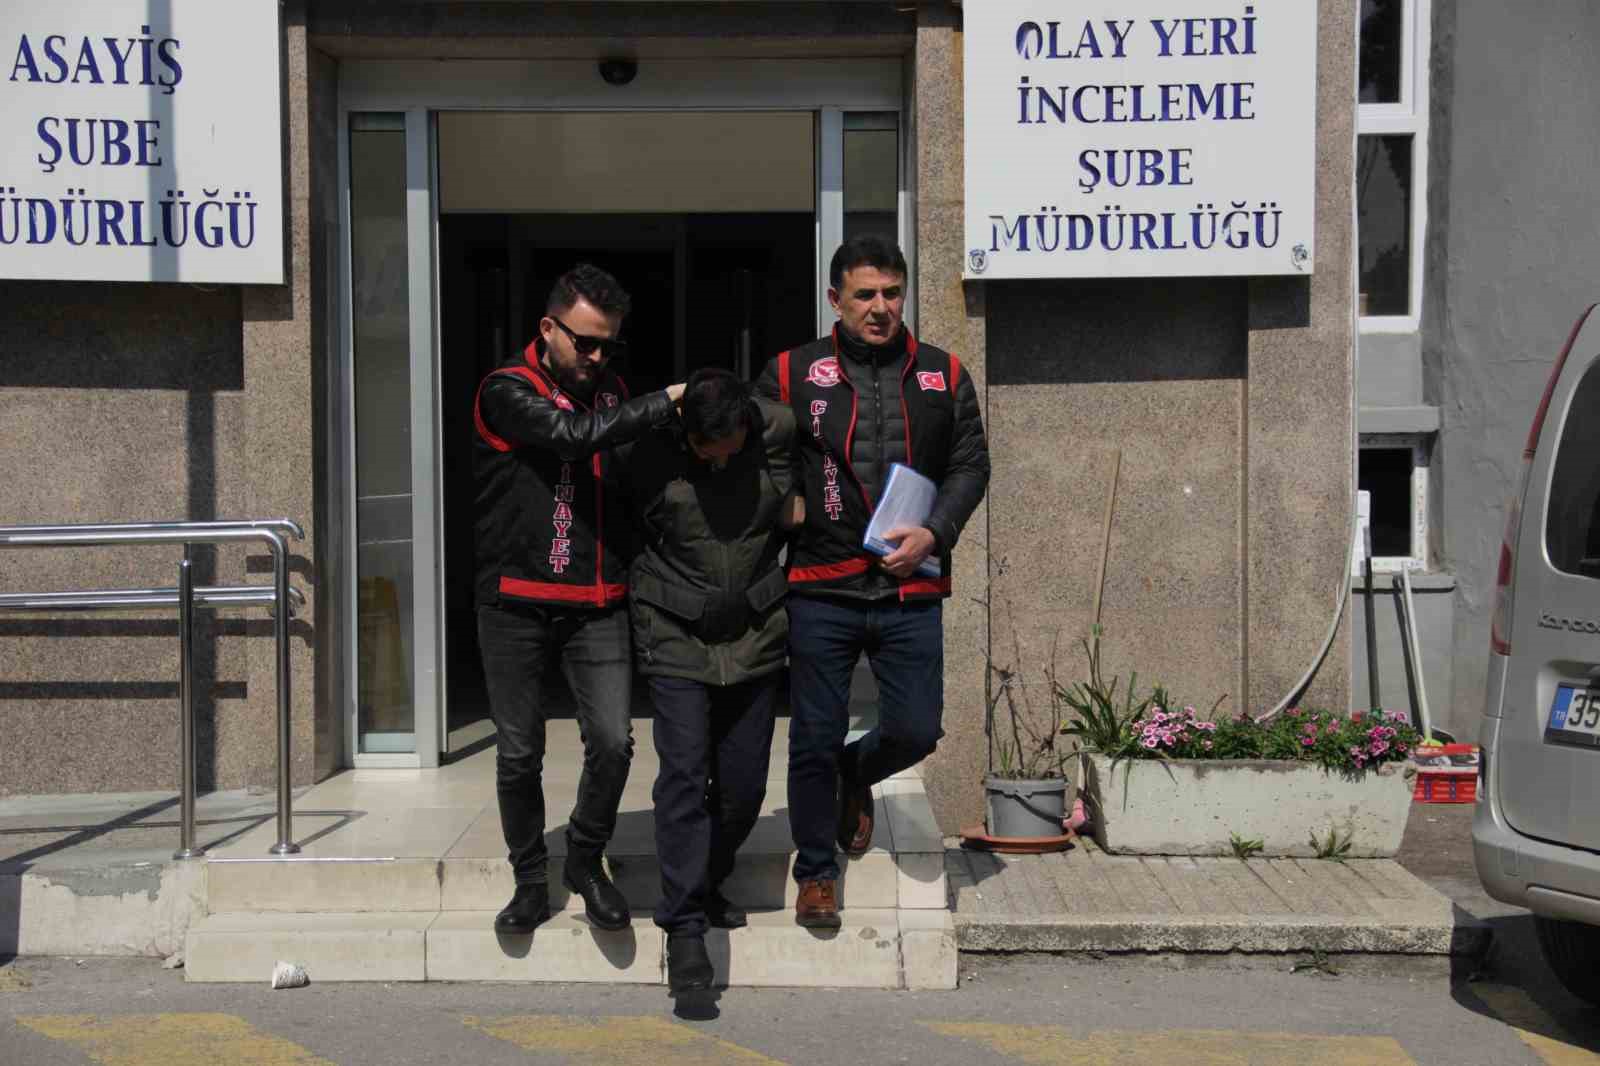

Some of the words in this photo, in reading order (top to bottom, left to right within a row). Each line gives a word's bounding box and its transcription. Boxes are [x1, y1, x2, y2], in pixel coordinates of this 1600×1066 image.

[1015, 19, 1135, 60] OLAY
[1150, 6, 1257, 57] YERİ
[9, 25, 184, 95] ASAYİŞ
[1017, 76, 1256, 124] İNCELEME
[37, 116, 162, 173] ŞUBE
[1078, 148, 1193, 194] ŞUBE
[988, 201, 1283, 252] MÜDÜRLÜĞÜ
